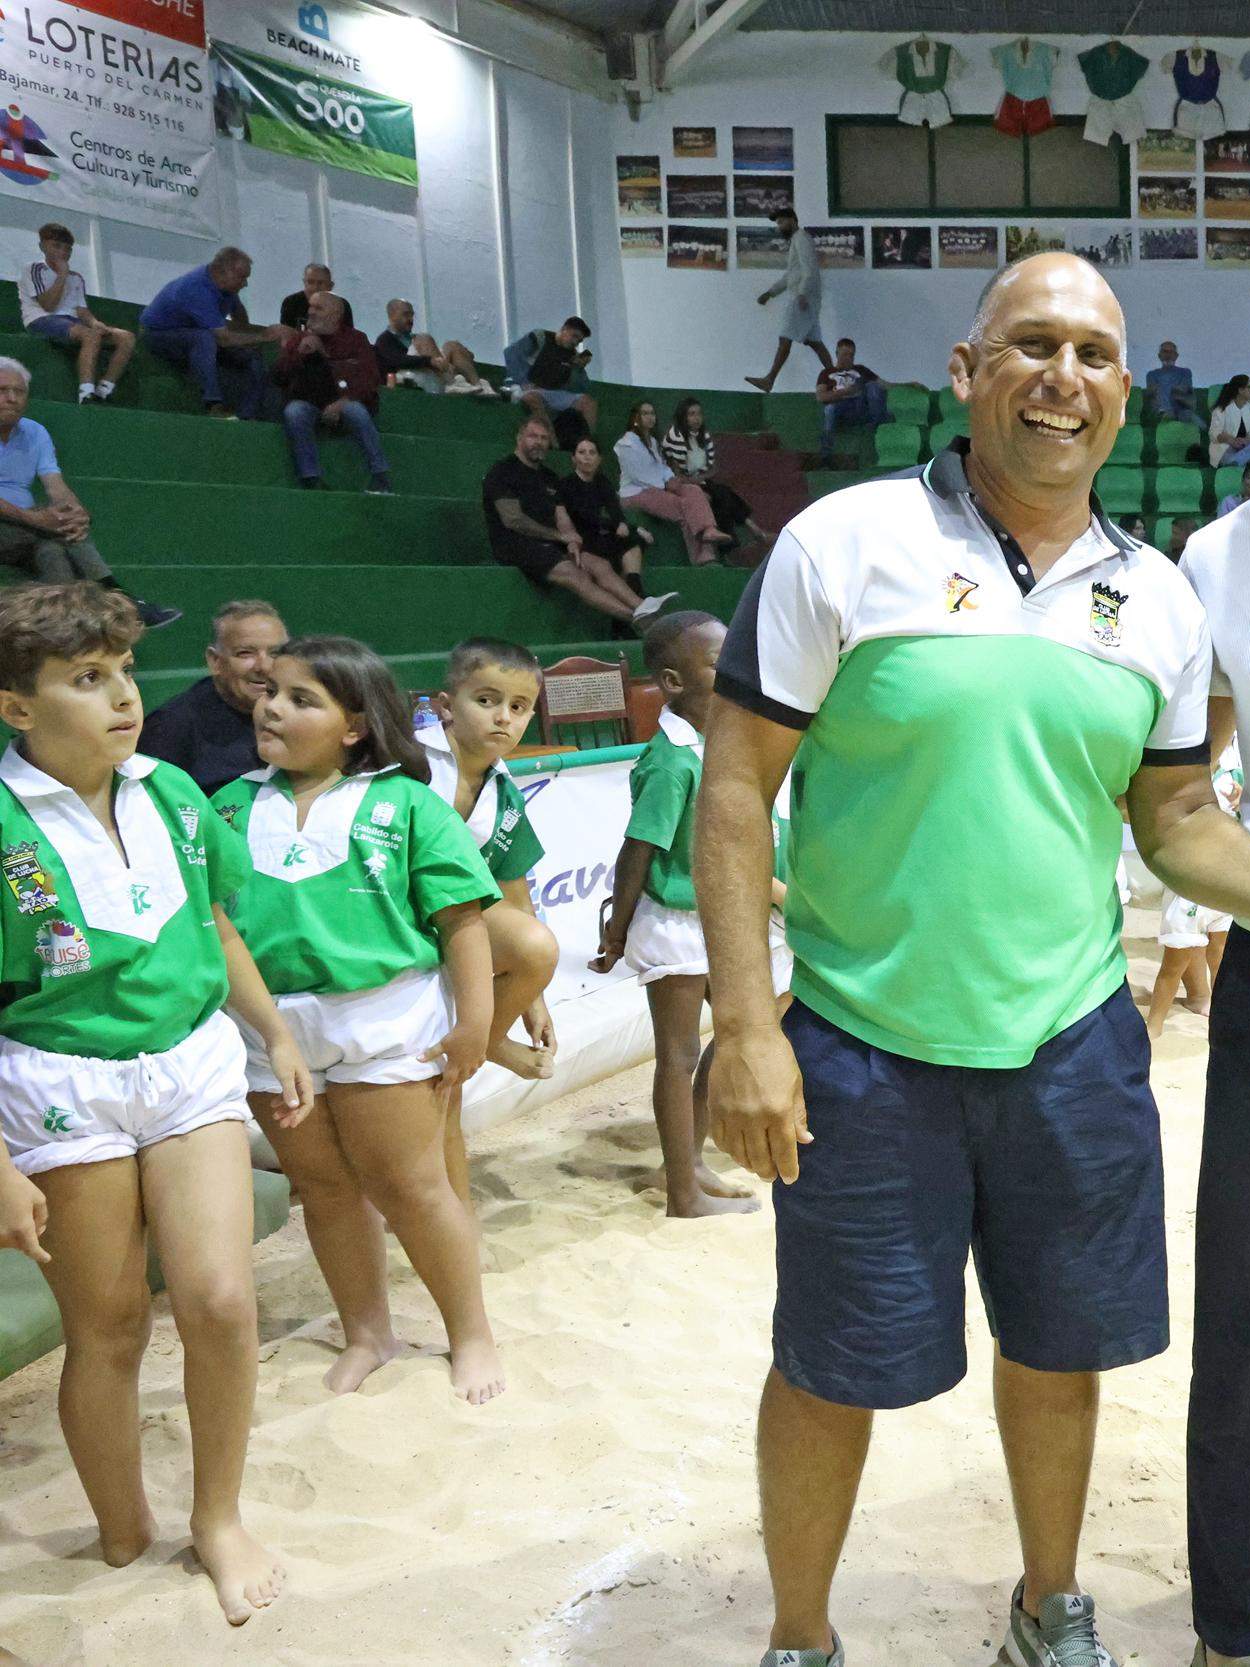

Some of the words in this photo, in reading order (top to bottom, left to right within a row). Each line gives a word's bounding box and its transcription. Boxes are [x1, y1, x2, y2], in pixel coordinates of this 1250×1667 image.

[25, 7, 203, 93] LOTERIAS
[266, 28, 320, 59] BEACH
[323, 50, 362, 72] MATE
[29, 50, 95, 78] PUERTO
[105, 73, 134, 91] DEL
[142, 85, 203, 110] CARMEN
[113, 102, 135, 118] 928
[139, 110, 160, 125] 515
[164, 118, 185, 132] 116
[70, 131, 133, 161] Centros
[138, 150, 156, 167] de
[161, 156, 199, 179] Arte,
[72, 153, 129, 181] Cultura
[131, 171, 140, 187] y
[143, 170, 199, 197] Turismo
[13, 864, 30, 873] CLUB
